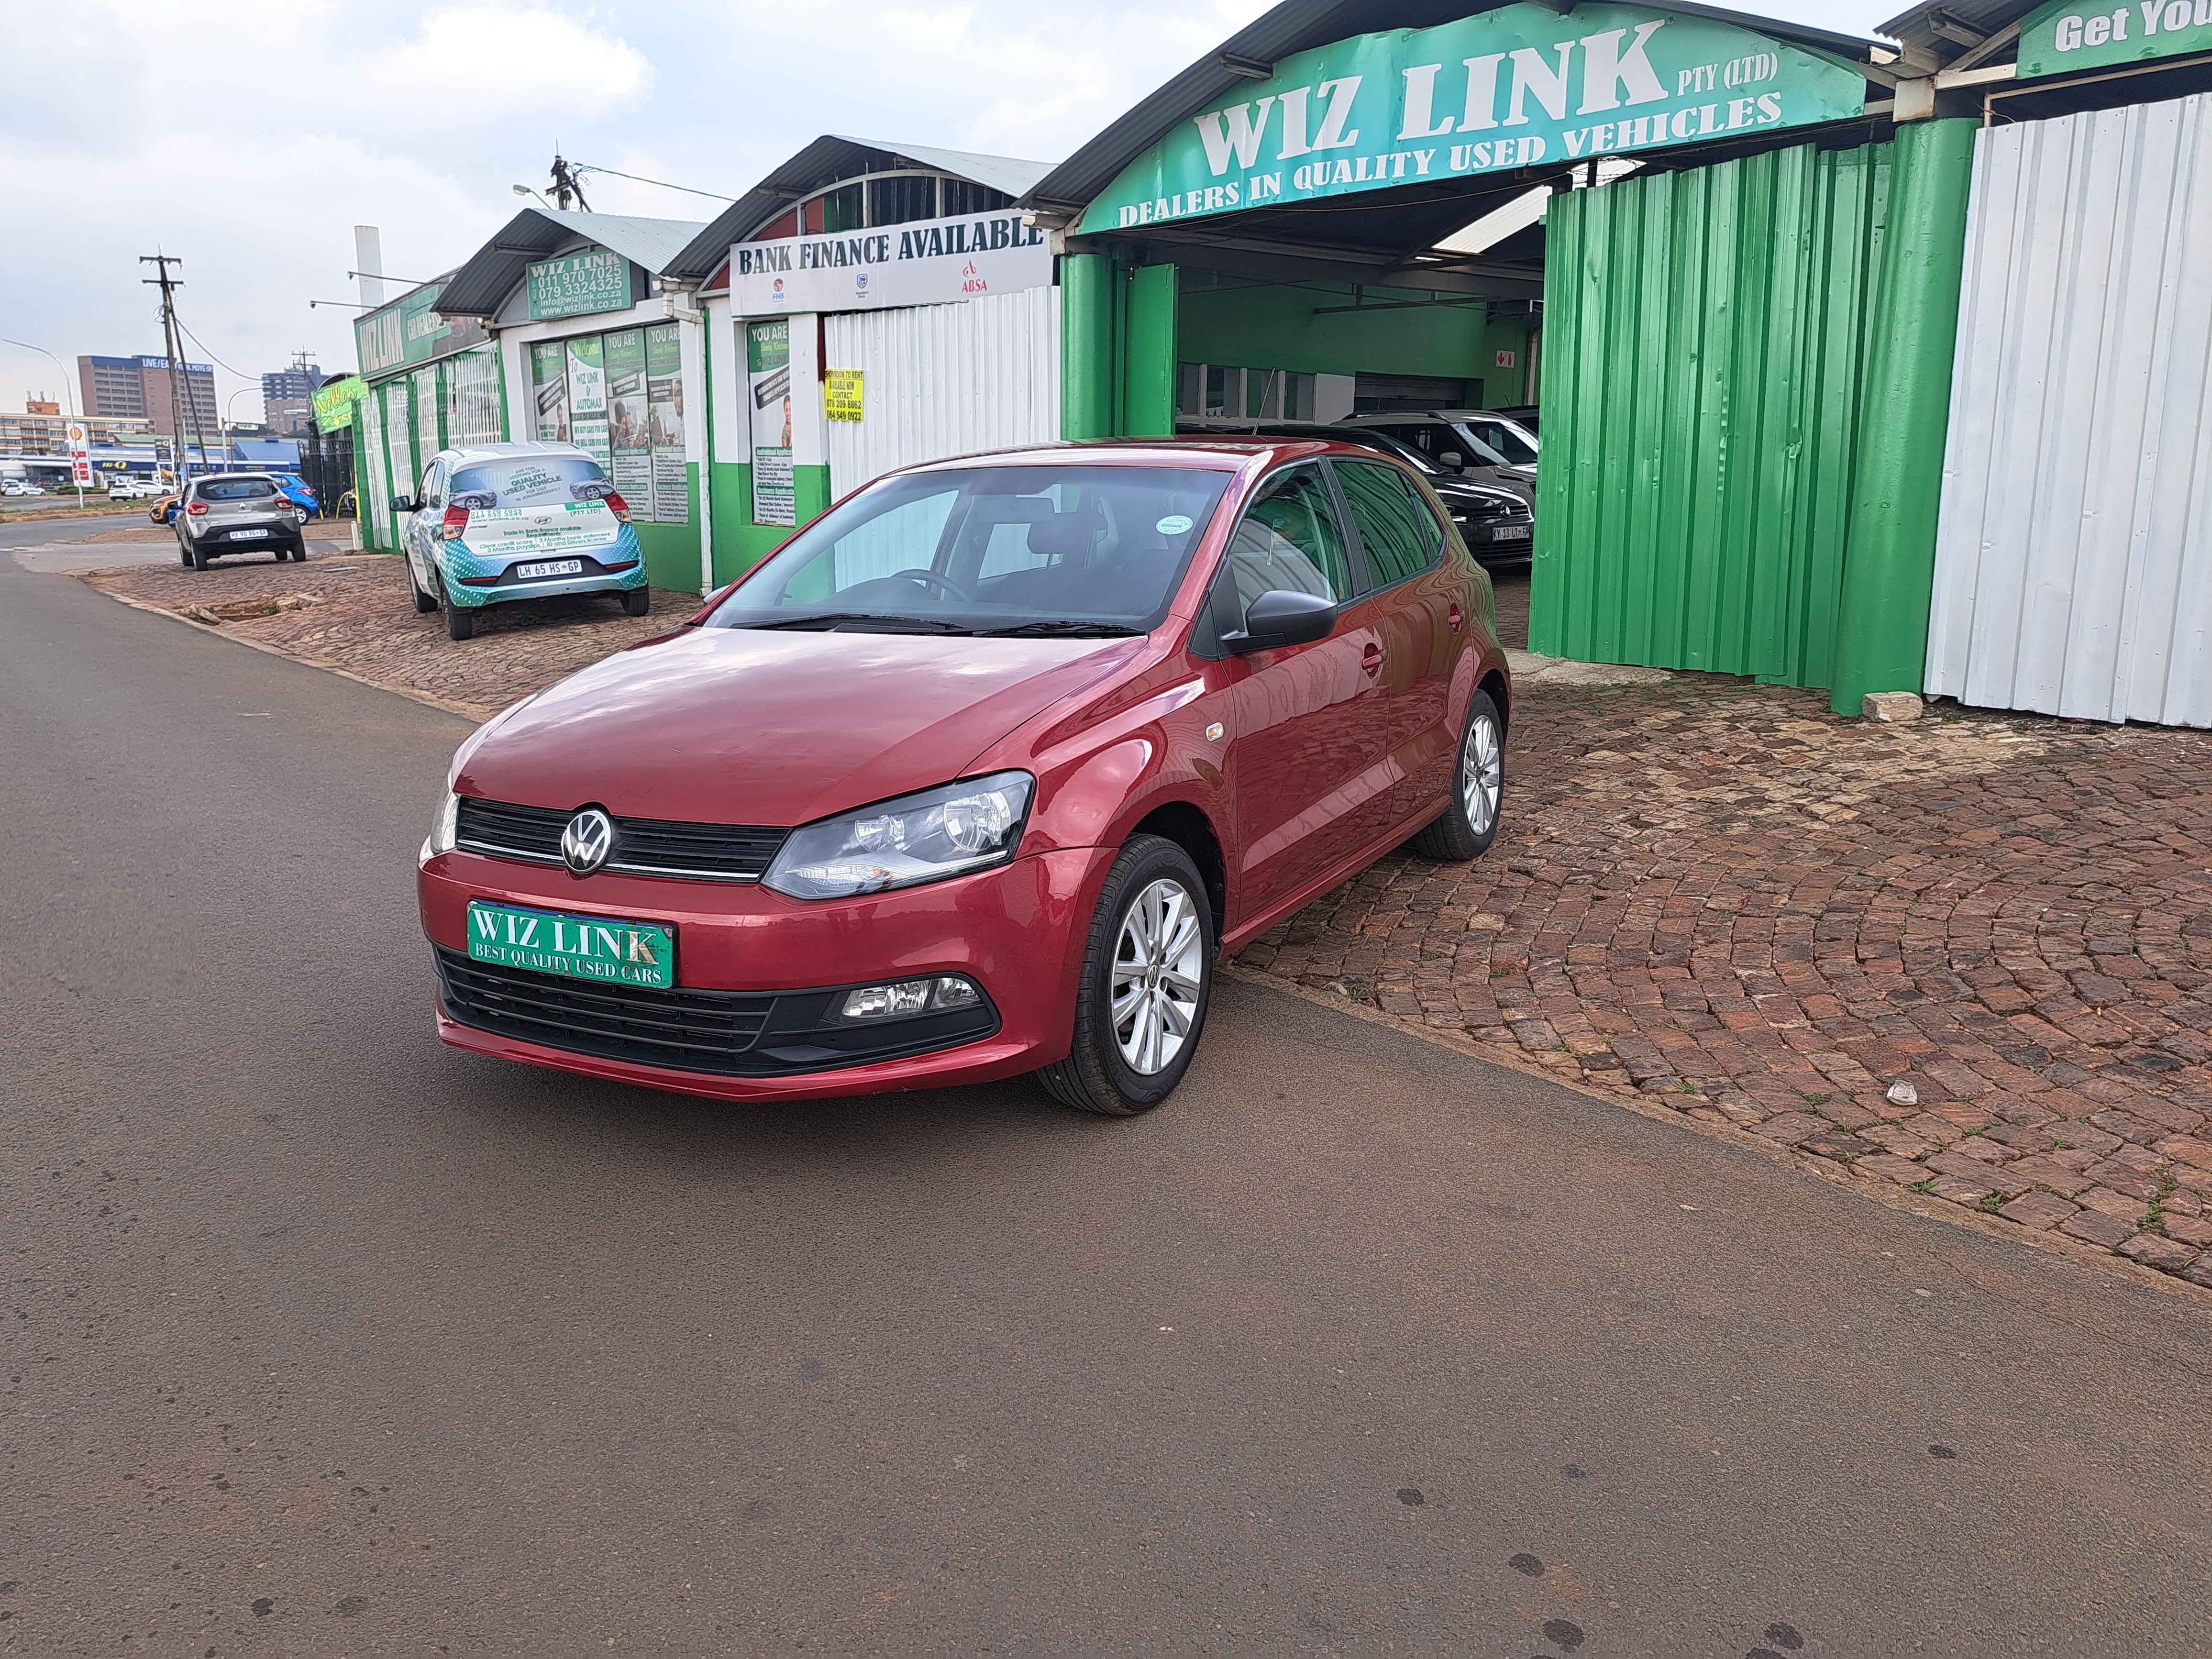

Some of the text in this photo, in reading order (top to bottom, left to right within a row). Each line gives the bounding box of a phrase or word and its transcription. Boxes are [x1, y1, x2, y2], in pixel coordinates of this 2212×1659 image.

[2055, 8, 2129, 52] Get
[1678, 52, 1778, 97] PTY (LTD)
[1193, 19, 1669, 177] WIZ LINK
[1118, 92, 1781, 228] DEALERS IN QUALITY USED VEHICLES
[739, 217, 1043, 275] BANK FINANCE AVAILABLE
[530, 253, 621, 277] WIZ LINK
[538, 264, 621, 288] 011 970 7025
[539, 276, 622, 299] 079 3324325
[962, 278, 987, 293] ABSA
[541, 299, 622, 316] www.wizlink.co.za
[608, 333, 636, 348] YOU ARE
[651, 329, 666, 343] YOU
[752, 325, 787, 342] YOU ARE
[534, 347, 546, 360] YOU
[576, 373, 586, 385] WIZ
[587, 371, 599, 384] LINK
[845, 371, 851, 379] TO
[852, 371, 863, 379] RENT
[846, 381, 854, 390] NOW
[576, 397, 603, 410] AUTOMAX
[827, 399, 862, 409] 078 209 8862
[827, 410, 862, 421] 064 549 0922
[502, 475, 563, 496] USED VEHICLE
[511, 472, 546, 486] QUALITY
[570, 509, 585, 518] (PTY
[1503, 528, 1510, 538] 13
[519, 561, 578, 576] LH 65 HS GP
[472, 909, 660, 965] WIZ LINK
[475, 942, 662, 984] BEST QUALITY USED CARS
